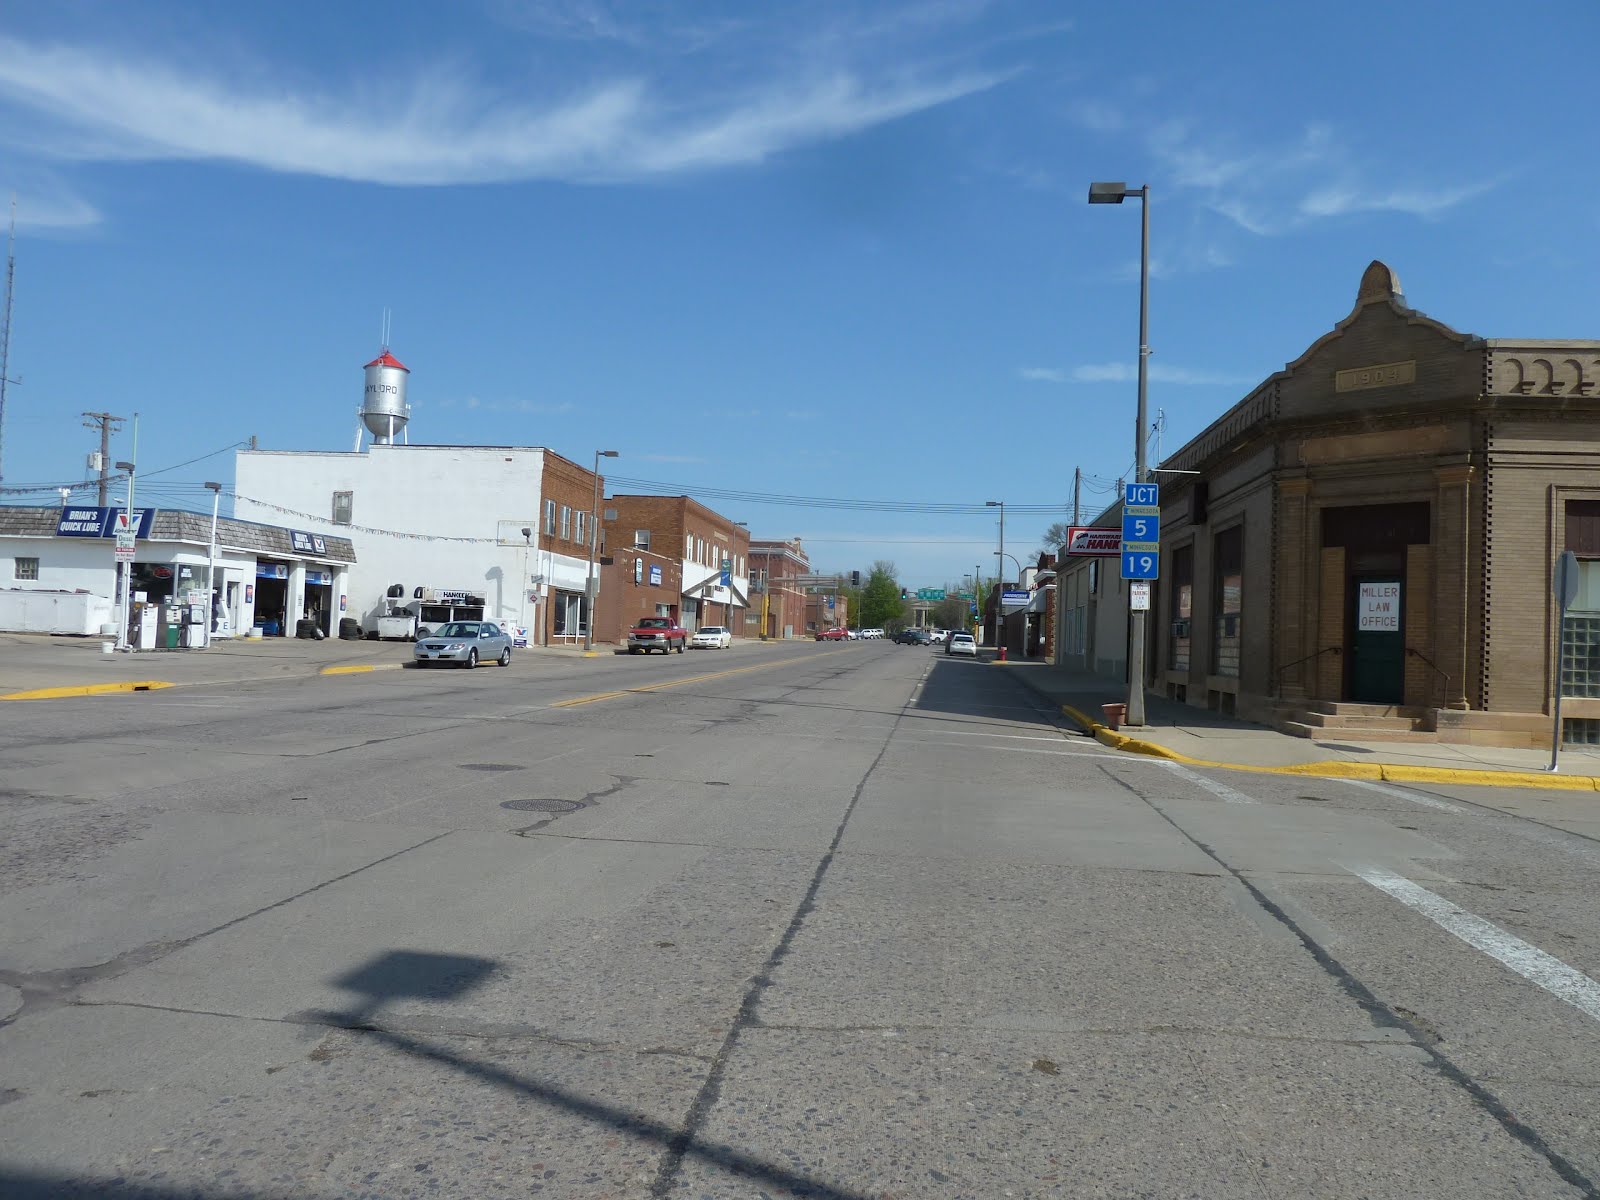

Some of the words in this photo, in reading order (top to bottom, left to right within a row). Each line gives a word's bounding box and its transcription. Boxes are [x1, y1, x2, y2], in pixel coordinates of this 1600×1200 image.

[365, 384, 398, 395] AYLORD
[1128, 487, 1155, 503] JCT
[69, 510, 98, 521] BRIAN'S
[60, 522, 81, 532] QUICK
[82, 522, 101, 532] LUBE
[1135, 520, 1147, 537] 5
[1086, 539, 1121, 549] HANK
[1128, 556, 1153, 573] 19
[1361, 587, 1398, 598] MILLER
[1368, 602, 1391, 612] LAW
[1361, 616, 1398, 627] OFFICE
